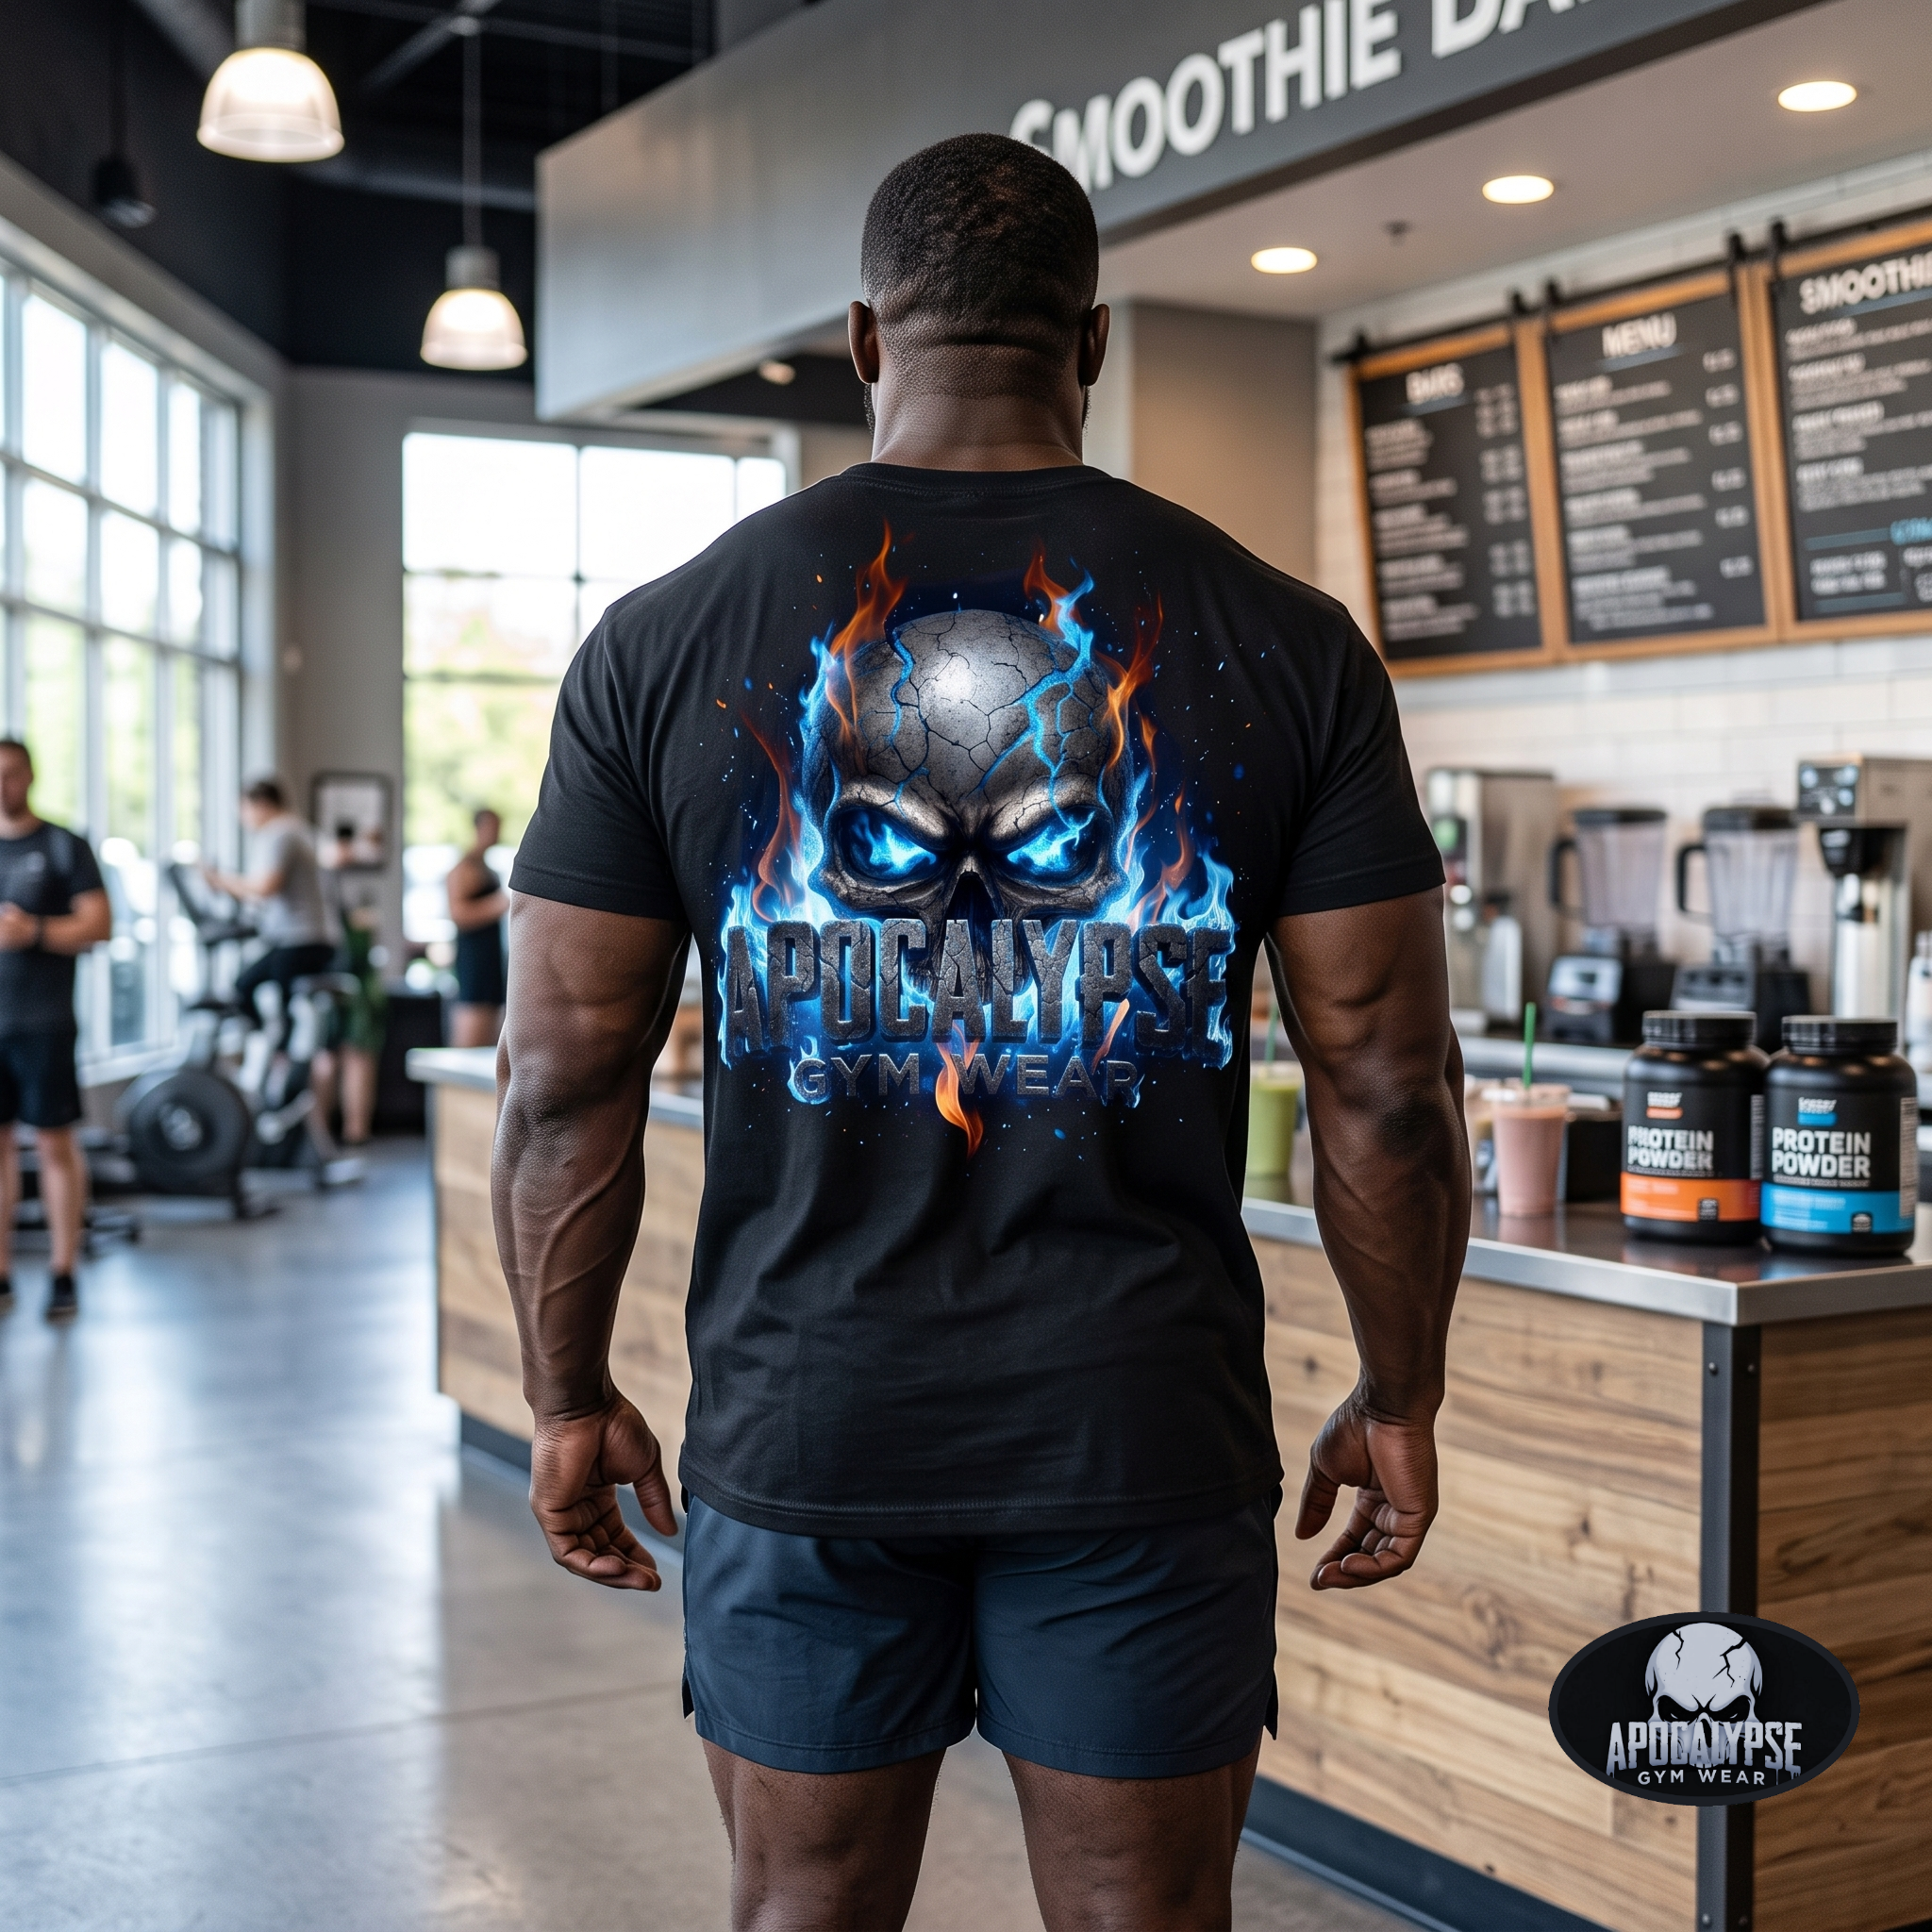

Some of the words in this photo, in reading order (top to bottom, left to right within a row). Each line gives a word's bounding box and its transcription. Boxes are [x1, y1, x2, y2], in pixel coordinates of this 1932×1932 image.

[1008, 0, 1402, 194] SMOOTHIE
[1602, 312, 1676, 358] MENU
[724, 918, 1230, 1059] APOCALYPSE
[792, 1053, 921, 1098] GYM
[951, 1053, 1140, 1103] WEAR
[1627, 1124, 1714, 1152] PROTEIN
[1772, 1126, 1872, 1156] PROTEIN
[1627, 1146, 1714, 1171] POWDER
[1772, 1150, 1872, 1178] POWDER
